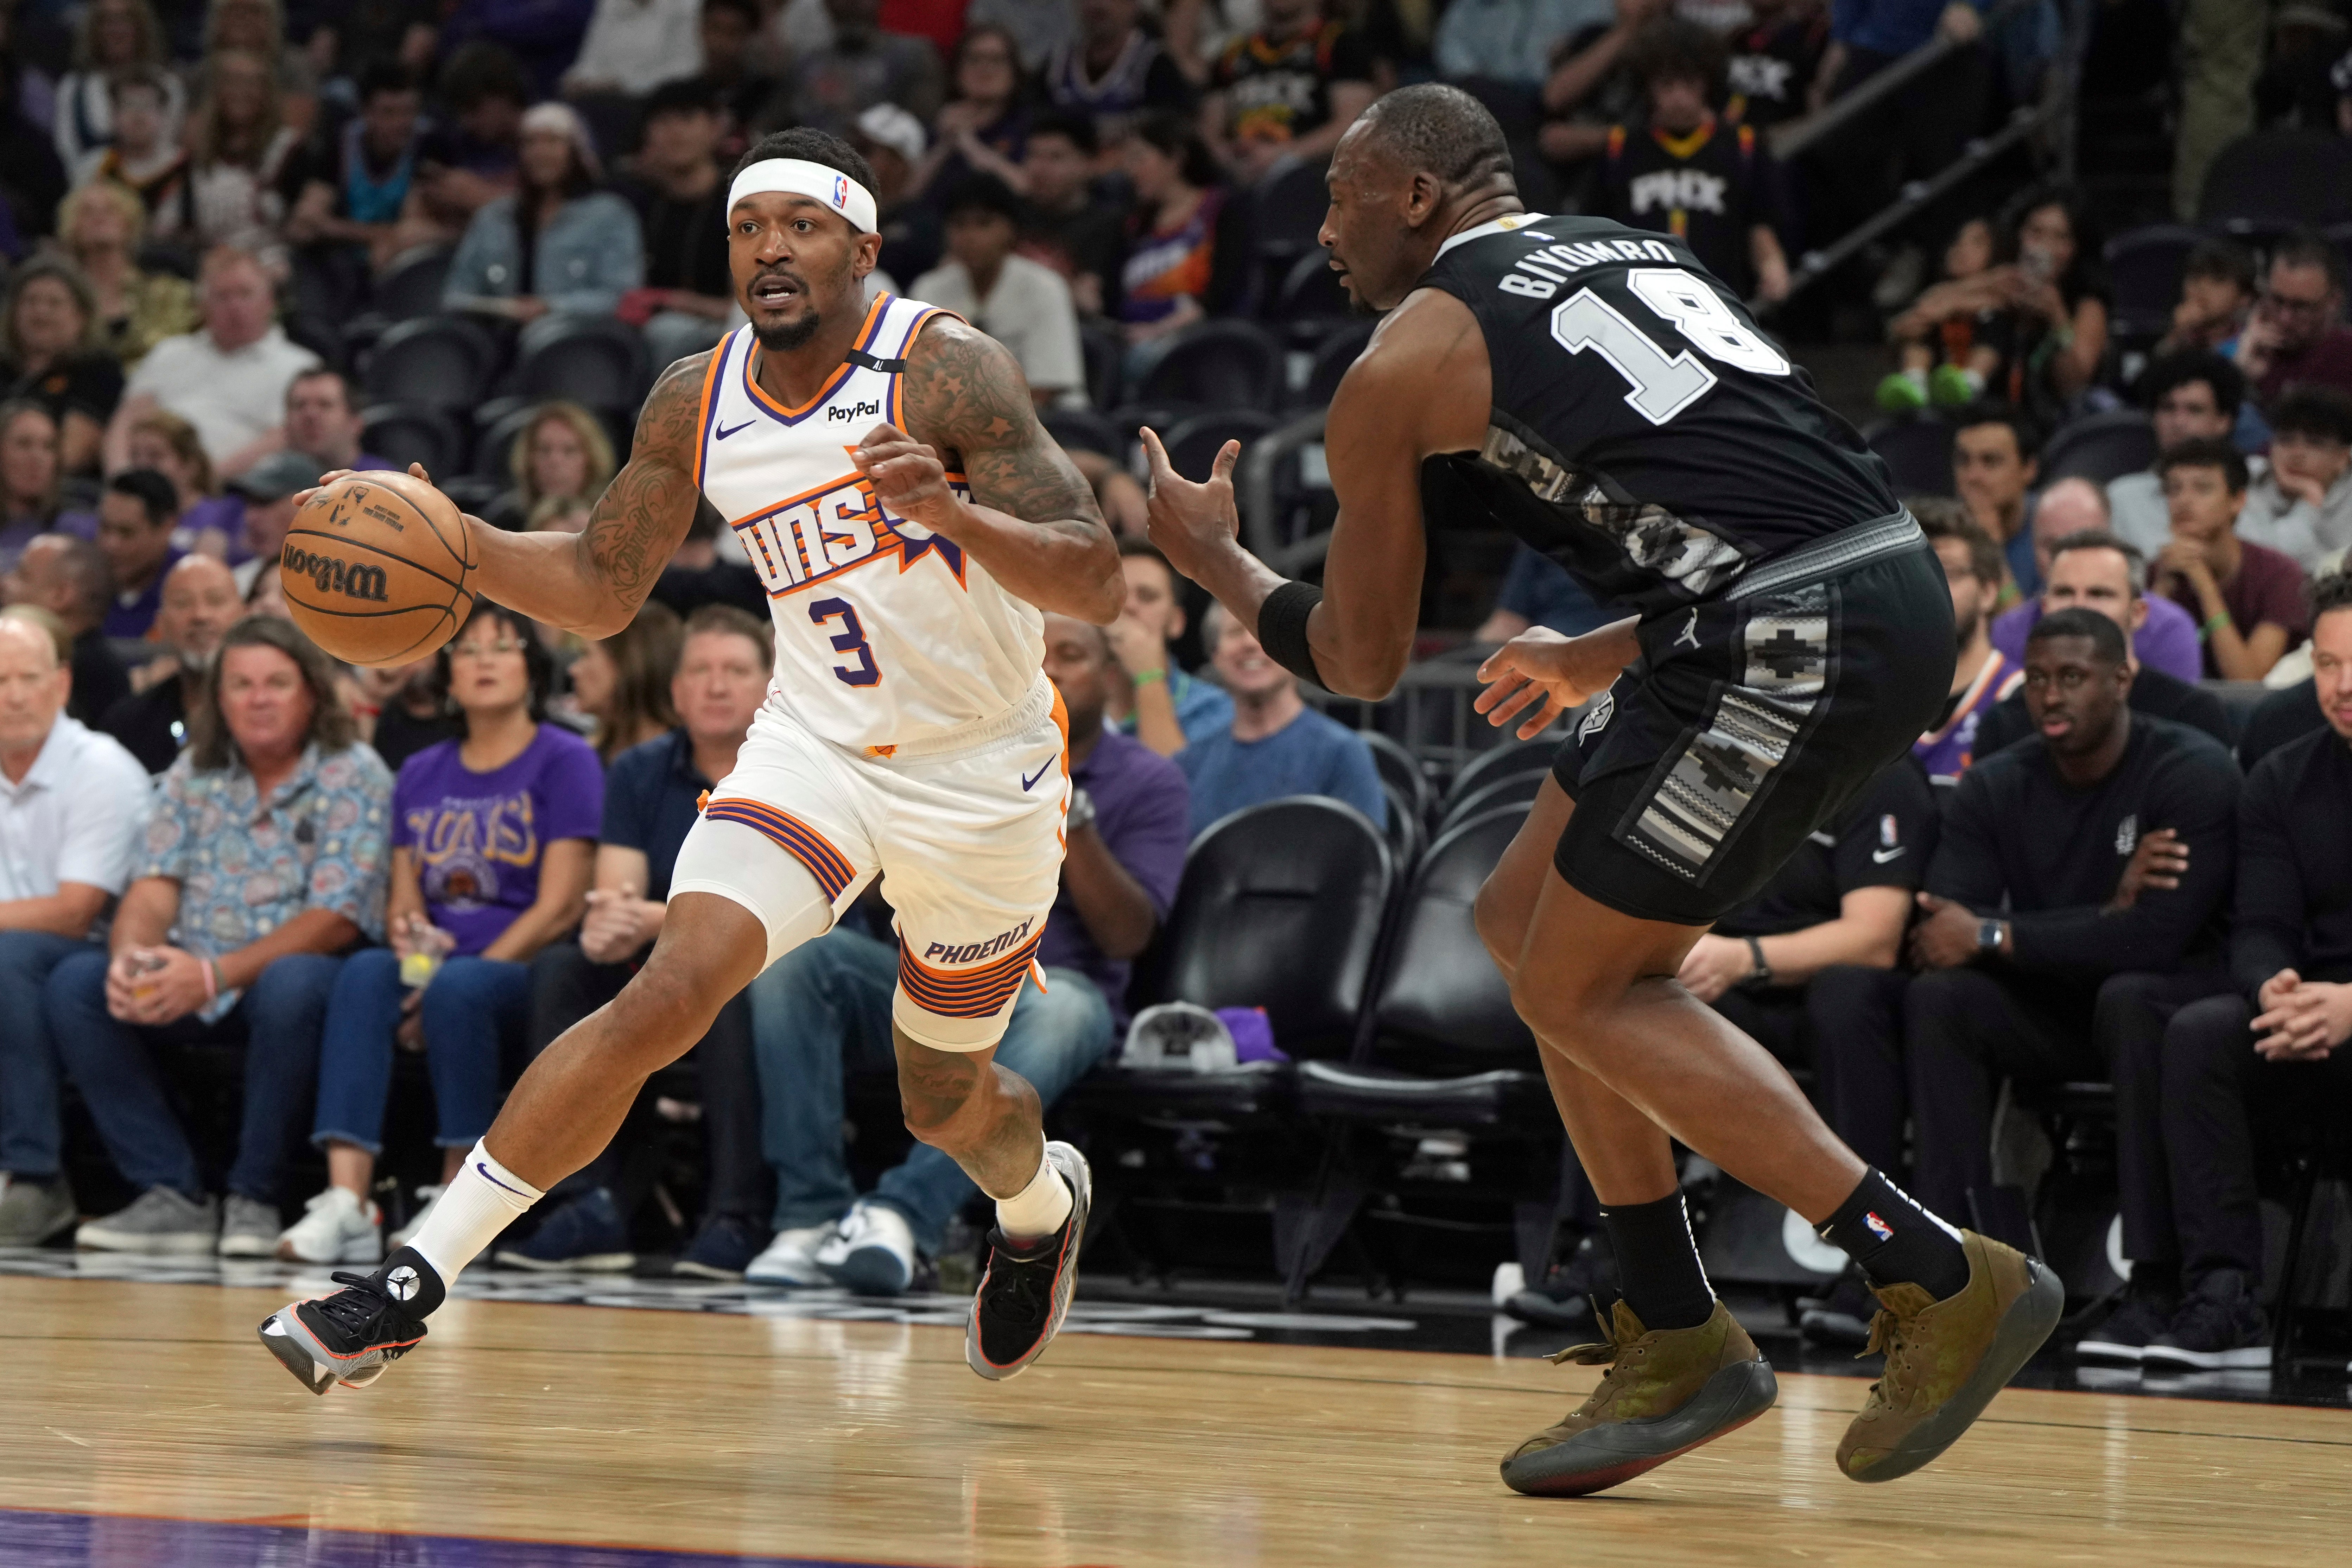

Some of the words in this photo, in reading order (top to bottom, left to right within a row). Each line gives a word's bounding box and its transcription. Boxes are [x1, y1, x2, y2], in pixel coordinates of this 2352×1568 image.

[872, 360, 884, 370] AL
[1551, 268, 1790, 426] 18
[829, 399, 879, 423] PayPal
[737, 485, 876, 592] UNS
[283, 543, 388, 602] Wilson
[809, 597, 882, 688] 3
[924, 915, 1034, 964] PHOENIX
